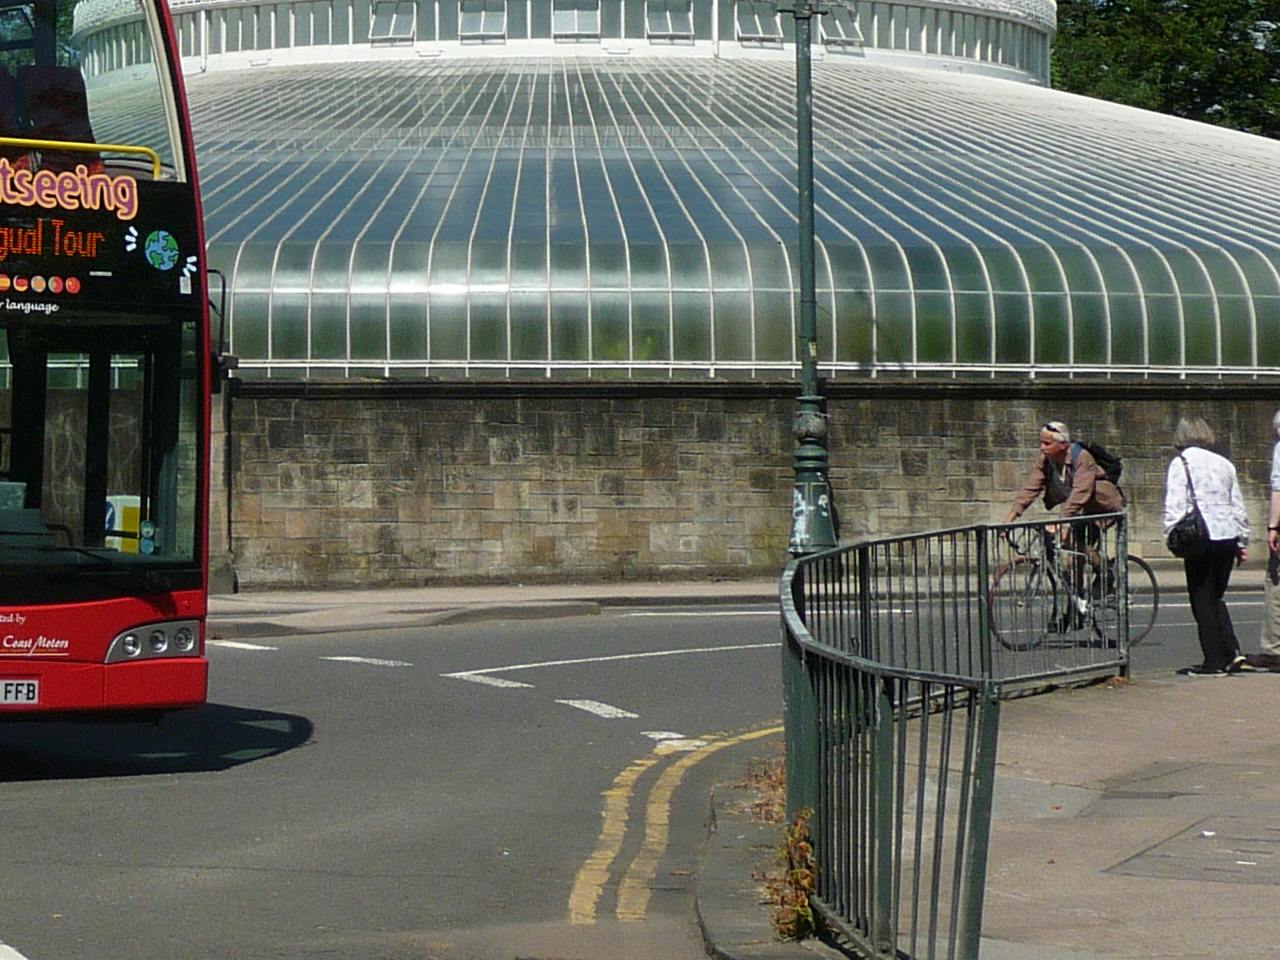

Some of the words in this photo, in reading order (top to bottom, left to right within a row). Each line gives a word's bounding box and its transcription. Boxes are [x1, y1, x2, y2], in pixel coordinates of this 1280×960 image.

[52, 219, 105, 258] Tour
[5, 298, 60, 315] language
[14, 613, 26, 624] by
[3, 635, 32, 648] Coast
[28, 635, 69, 656] Motors
[4, 682, 36, 701] FFB
